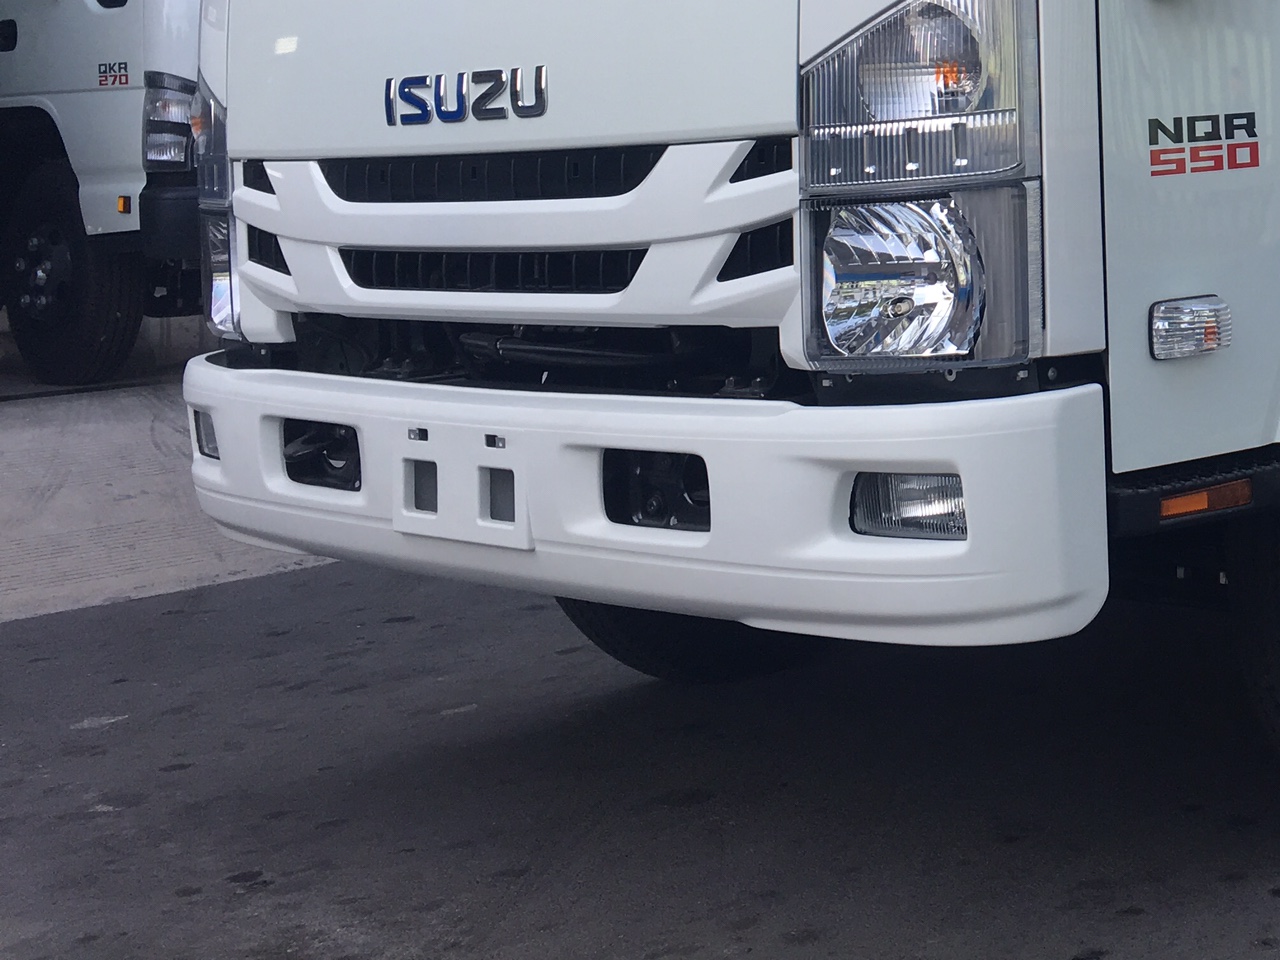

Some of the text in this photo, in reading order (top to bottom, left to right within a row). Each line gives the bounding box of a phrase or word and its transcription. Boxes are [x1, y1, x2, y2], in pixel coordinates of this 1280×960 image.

[98, 61, 128, 75] QKR
[98, 73, 129, 87] 270
[384, 64, 549, 127] ISUZU
[1147, 111, 1259, 146] NQR
[1149, 141, 1260, 177] 550
